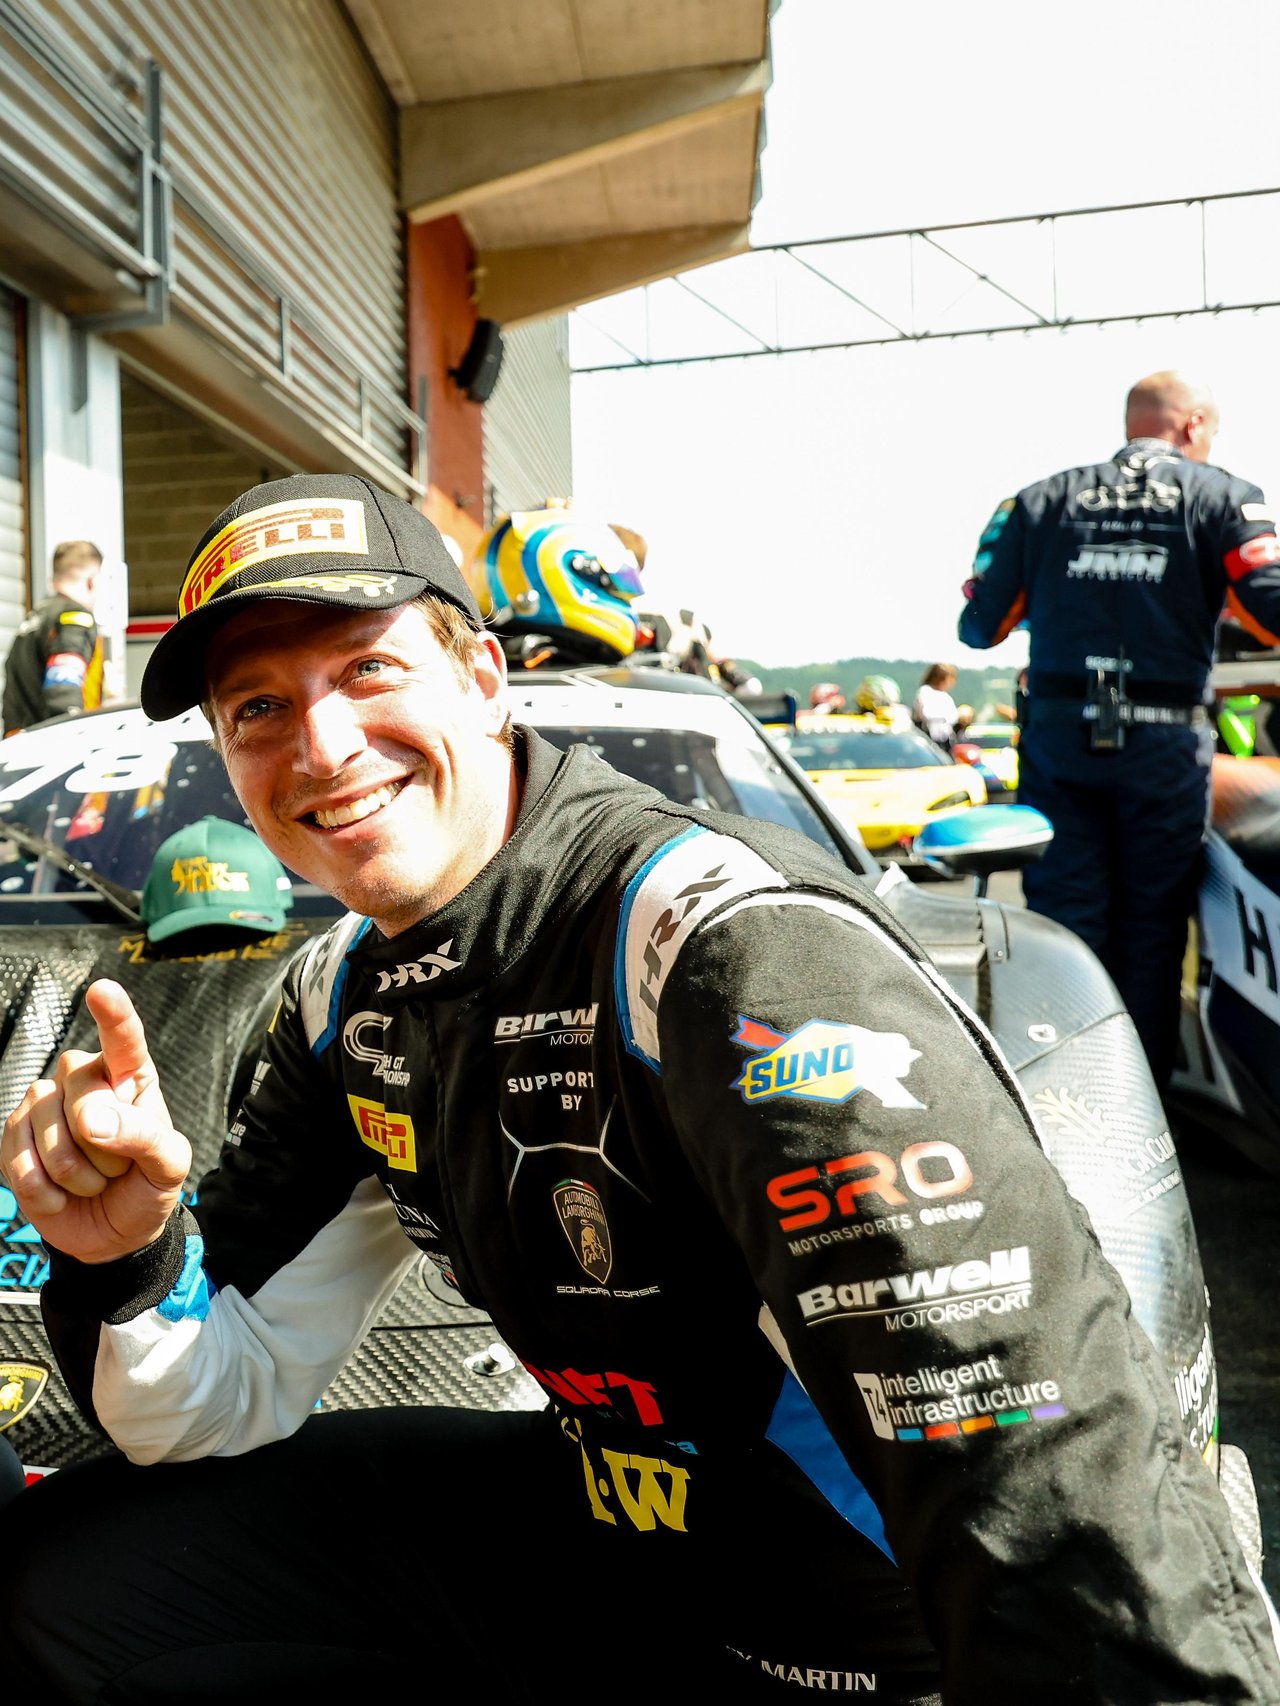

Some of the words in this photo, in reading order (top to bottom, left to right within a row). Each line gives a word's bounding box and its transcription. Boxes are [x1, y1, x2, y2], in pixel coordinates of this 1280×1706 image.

[183, 507, 345, 612] PIRELLI
[377, 938, 462, 993] HRX
[561, 1094, 582, 1111] BY
[766, 1141, 973, 1232] SRO
[788, 1213, 915, 1257] MOTORSPORTS
[919, 1200, 984, 1226] GROUP
[557, 1286, 611, 1298] SQUADRA
[613, 1286, 660, 1299] CORSE
[797, 1246, 1032, 1319] Barwell
[884, 1289, 1032, 1332] MOTORSPORT
[880, 1354, 1003, 1398] intelligent
[861, 1387, 887, 1424] T4
[888, 1379, 1062, 1426] infrastructure
[760, 1660, 878, 1693] MARTIN
